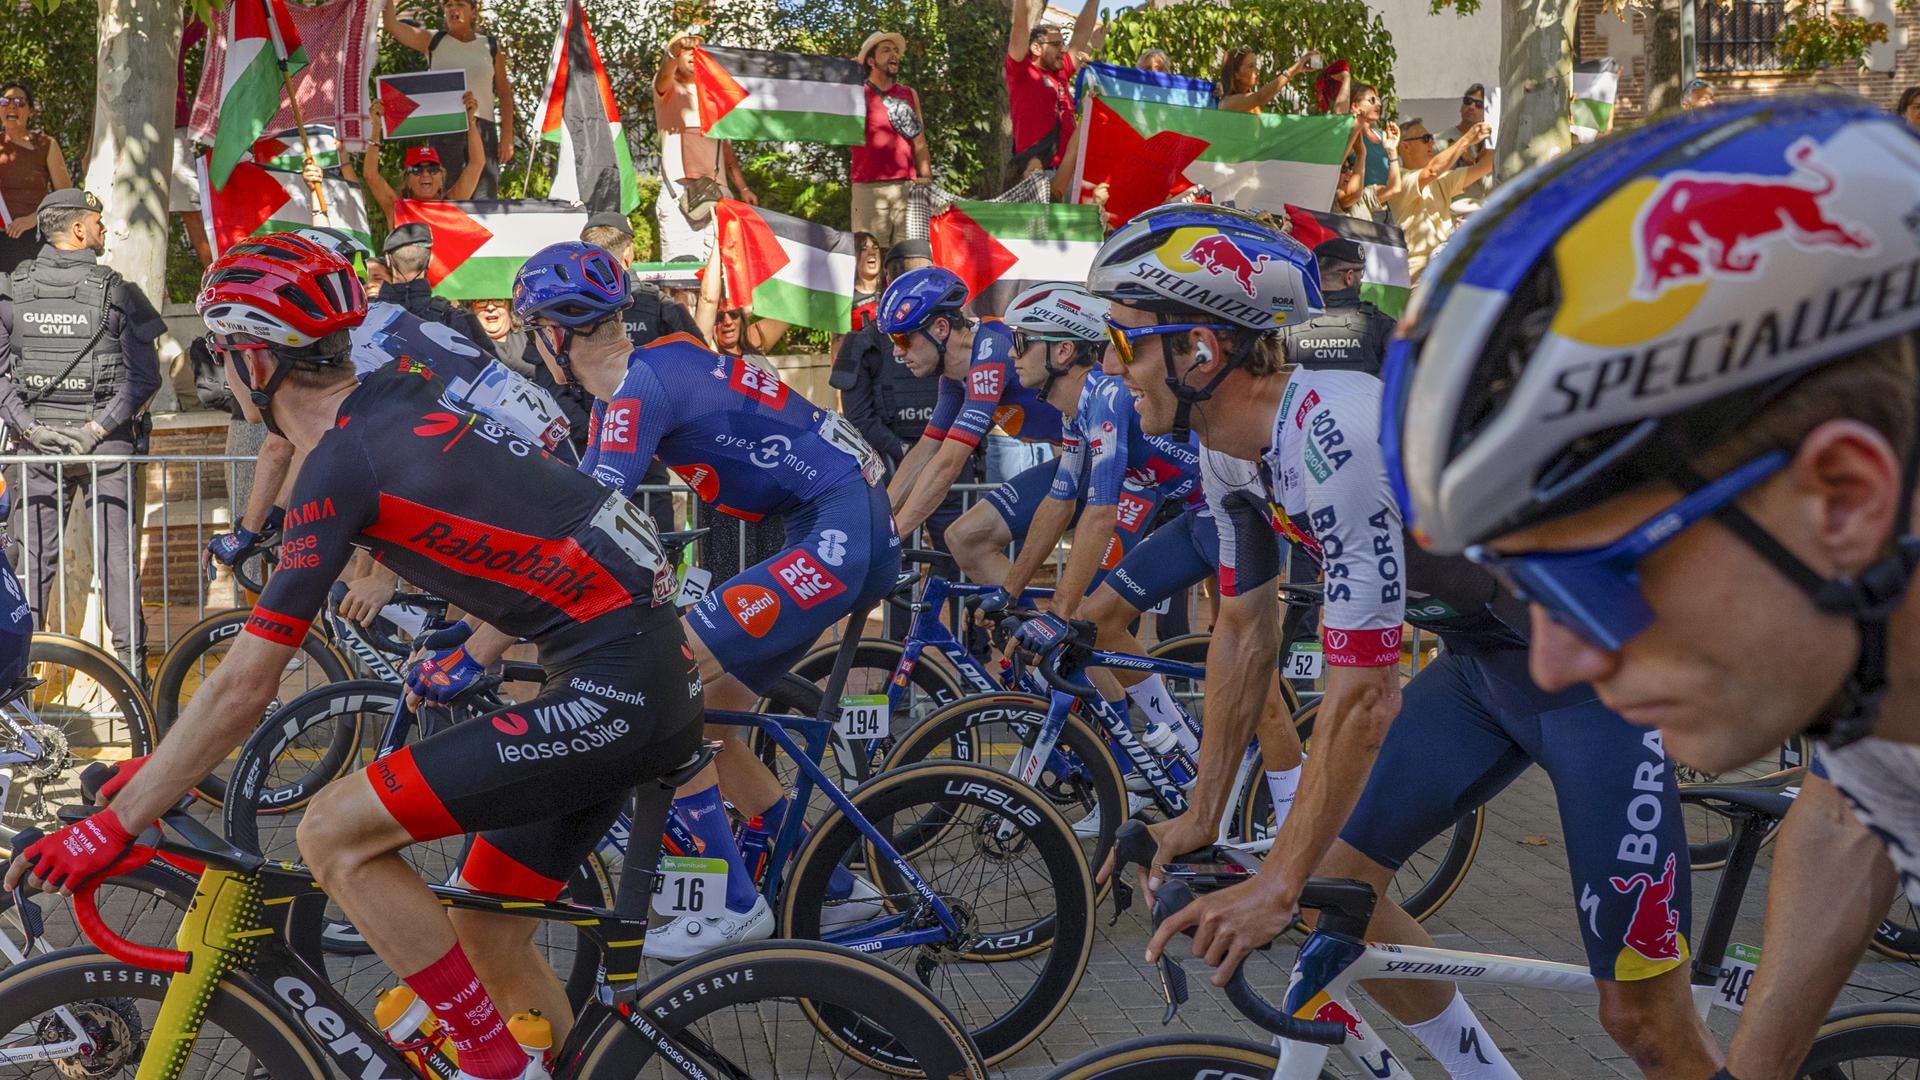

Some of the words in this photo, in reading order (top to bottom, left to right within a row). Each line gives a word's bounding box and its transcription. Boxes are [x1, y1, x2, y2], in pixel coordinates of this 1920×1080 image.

[1129, 261, 1273, 326] SPECIALIZED
[23, 312, 88, 325] GUARDIA
[39, 324, 75, 335] CIVIL
[1028, 306, 1100, 340] SPECIALIZED
[1299, 338, 1361, 349] GUARDIA
[1314, 348, 1349, 359] CIVIL
[25, 374, 87, 390] 1G1105
[1311, 408, 1353, 471] BORA
[715, 432, 757, 451] eyes
[783, 453, 818, 481] more
[1305, 448, 1328, 479] grohe
[408, 521, 598, 603] Rabobank
[1369, 507, 1400, 604] BORA
[779, 556, 816, 586] PIC
[1295, 655, 1313, 676] 52
[569, 677, 646, 707] Rabobank
[534, 696, 608, 735] VISMA
[846, 709, 879, 735] 194
[496, 739, 569, 763] lease
[1089, 700, 1190, 811] S-WORKS
[944, 780, 1042, 827] URSUS
[1617, 729, 1664, 865] BORA
[79, 832, 97, 854] VISMA
[672, 877, 705, 912] 16
[916, 880, 934, 903] VAYA
[84, 970, 173, 989] RESER
[1379, 960, 1486, 977] SPECIALIZED
[654, 968, 754, 1019] RESERVE
[629, 1012, 657, 1041] VISMA
[657, 1037, 684, 1065] lease
